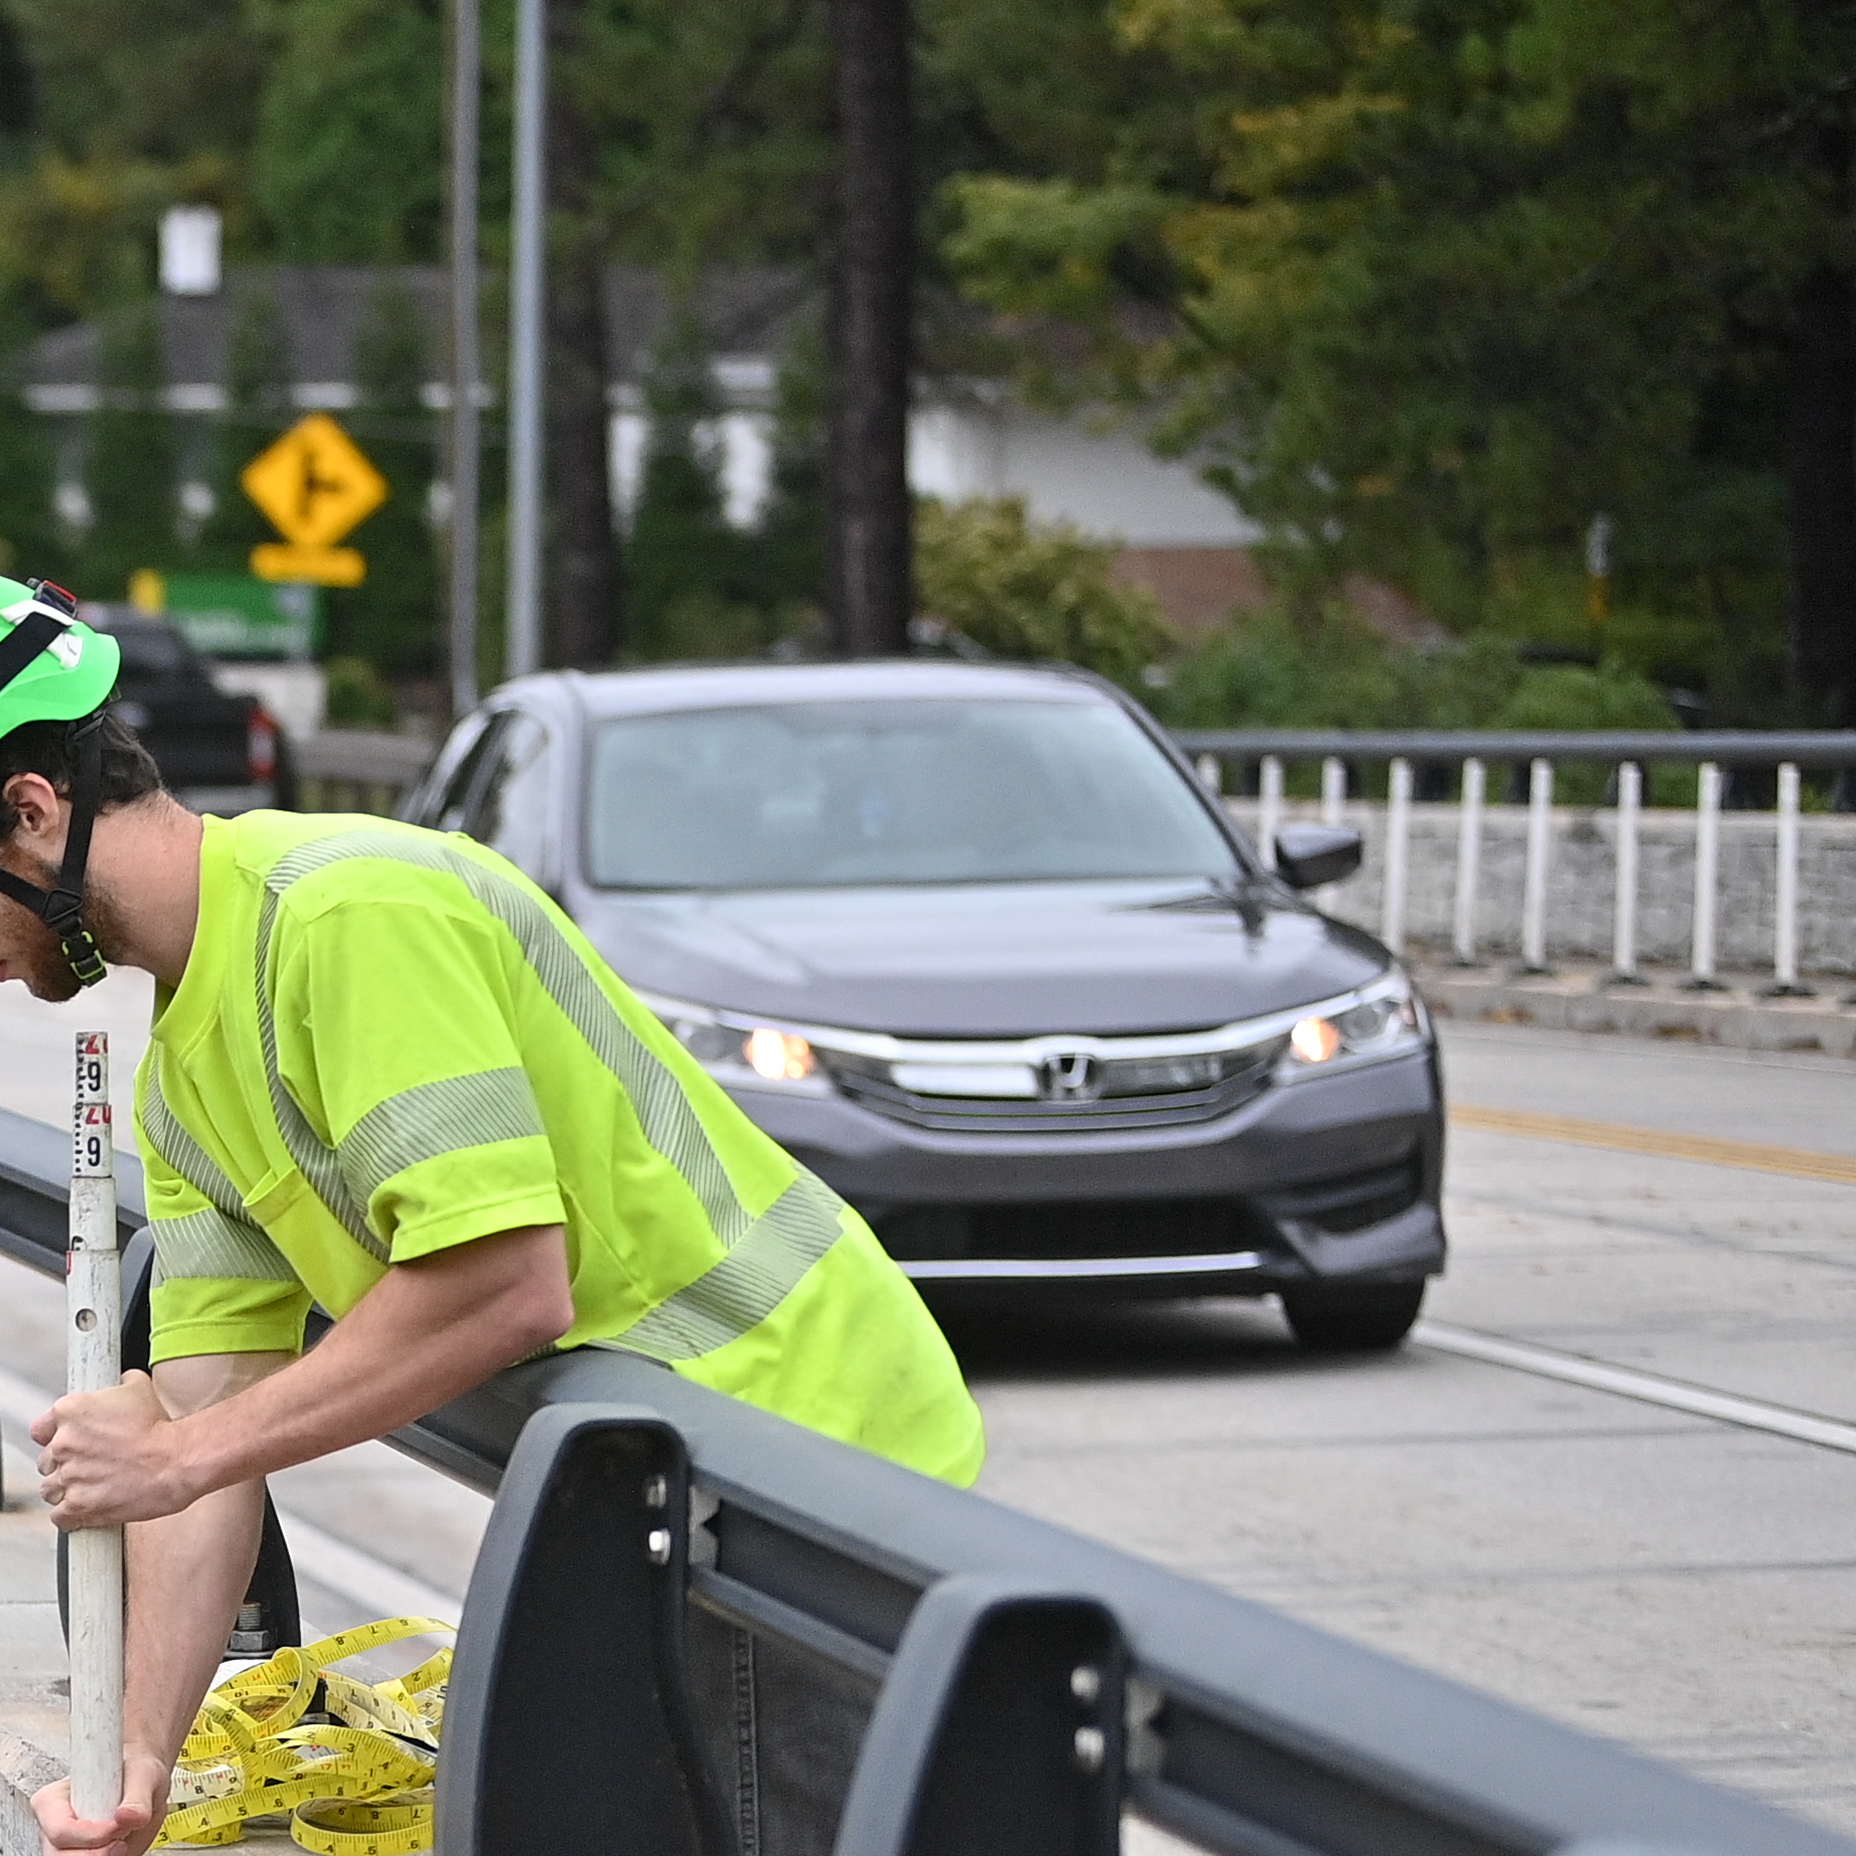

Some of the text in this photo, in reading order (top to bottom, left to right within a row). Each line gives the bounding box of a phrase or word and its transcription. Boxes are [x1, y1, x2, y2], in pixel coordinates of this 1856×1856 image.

[87, 1062, 101, 1092] 9
[87, 1136, 101, 1167] 9
[198, 1817, 209, 1828] .4
[237, 1806, 247, 1817] .5
[273, 1798, 284, 1808] .6
[364, 1845, 377, 1856] .5
[407, 1839, 419, 1850] .6
